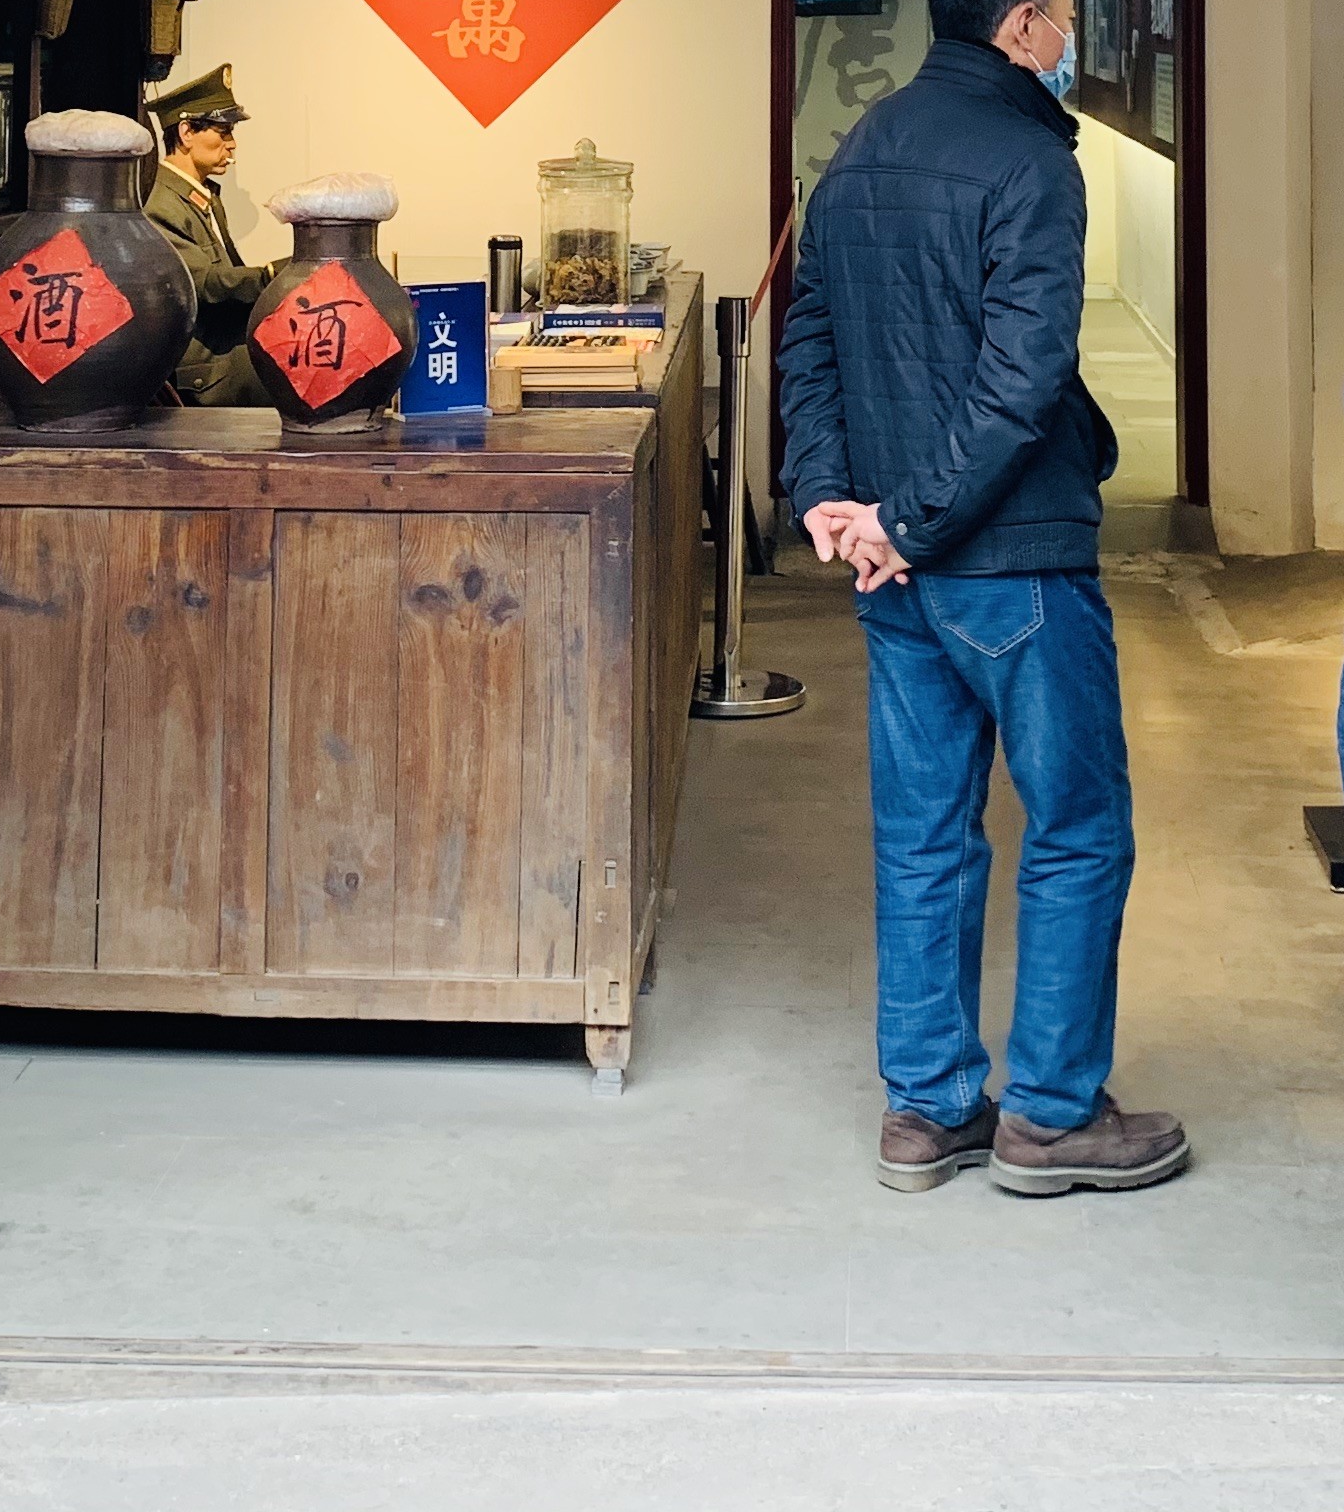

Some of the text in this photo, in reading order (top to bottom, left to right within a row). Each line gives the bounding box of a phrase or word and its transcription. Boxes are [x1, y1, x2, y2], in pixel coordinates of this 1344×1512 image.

[9, 263, 84, 350] 酒
[288, 295, 363, 371] 酒
[428, 312, 457, 385] 文明
